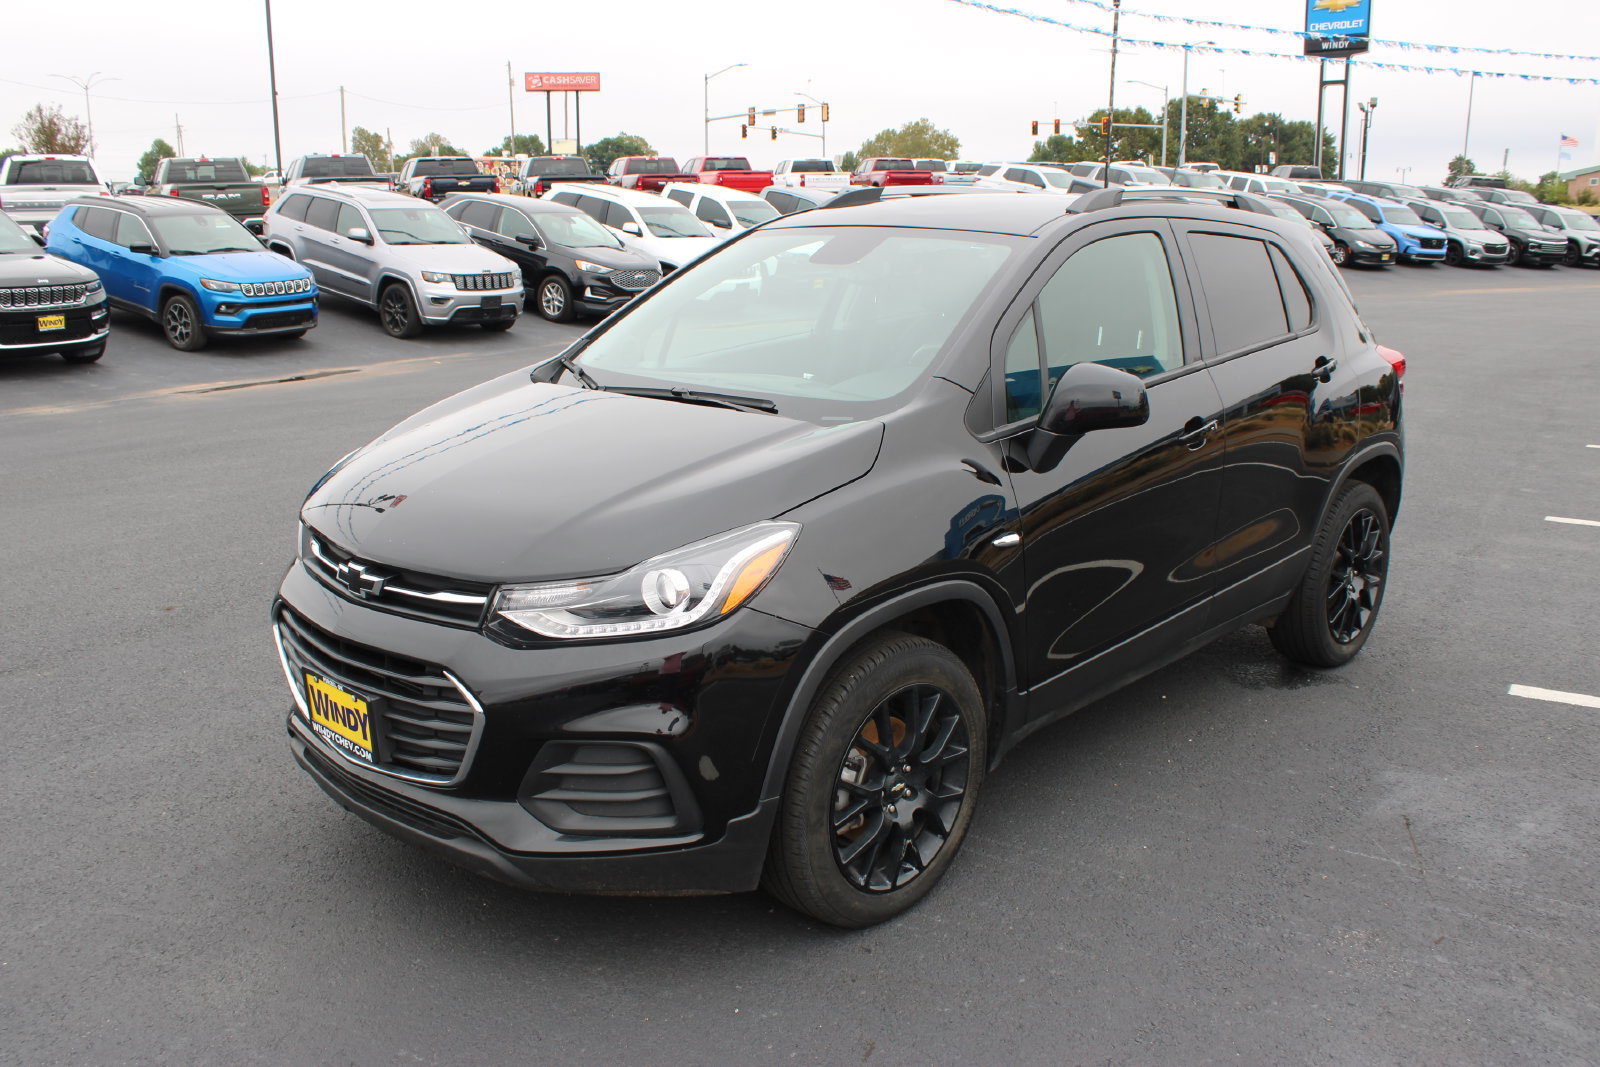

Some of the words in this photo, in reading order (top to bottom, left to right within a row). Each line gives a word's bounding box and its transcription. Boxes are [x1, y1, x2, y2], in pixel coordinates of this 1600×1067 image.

[1309, 19, 1364, 31] CHEVROLET
[1321, 40, 1350, 50] WINDY
[39, 318, 64, 328] WINDY
[309, 684, 369, 742] WINDY
[311, 720, 373, 763] WINDYCHEV.COM
